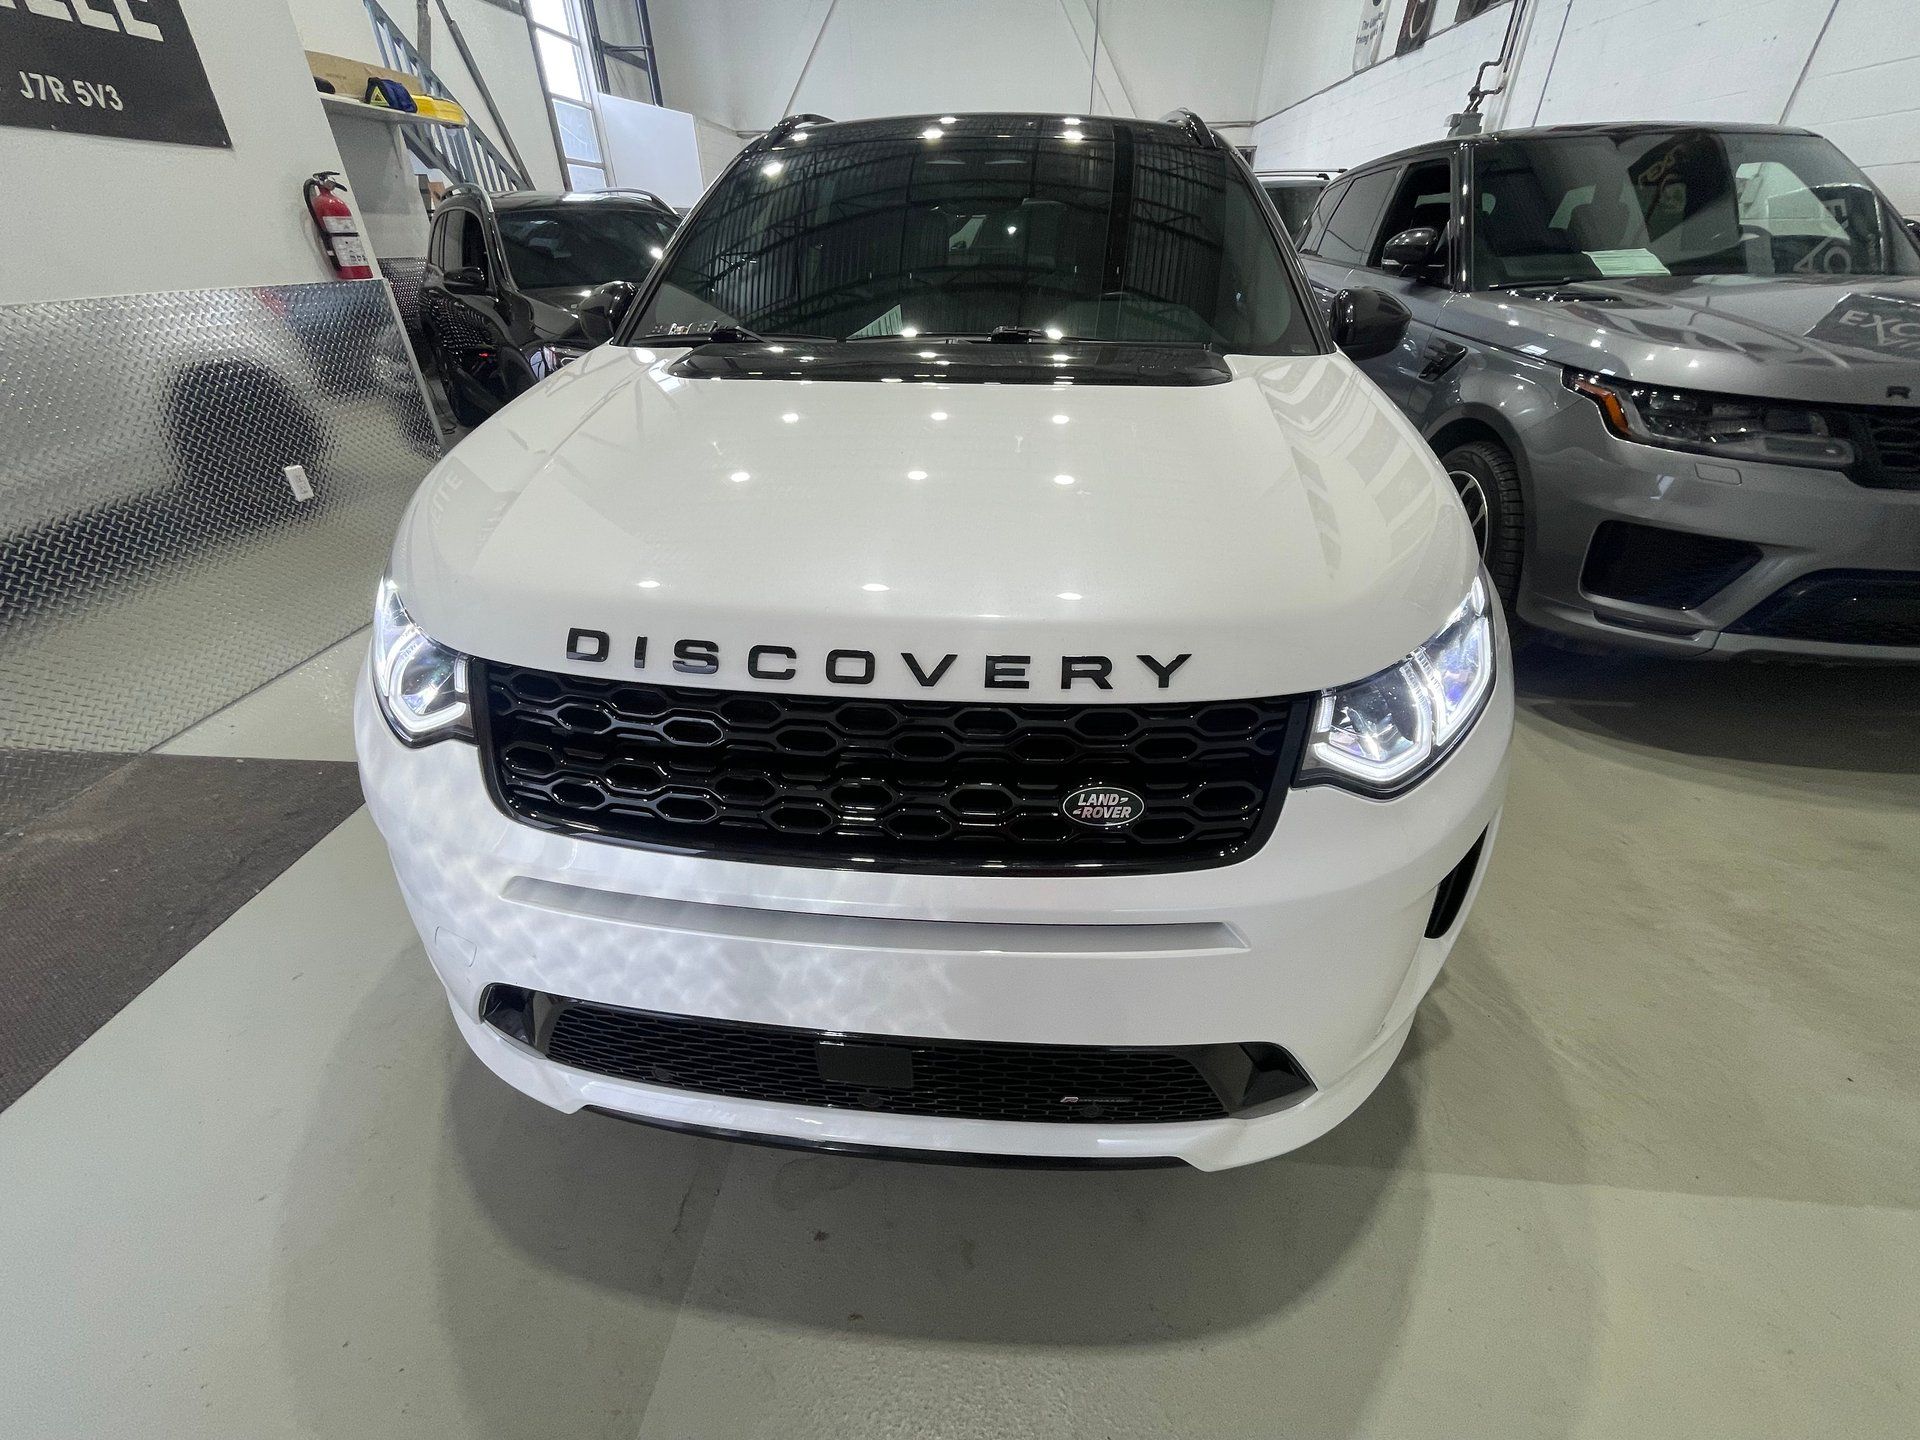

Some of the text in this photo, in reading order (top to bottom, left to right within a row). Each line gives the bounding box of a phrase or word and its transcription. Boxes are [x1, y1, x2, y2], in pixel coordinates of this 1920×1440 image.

[18, 70, 124, 112] J7R 5V3
[565, 627, 1193, 690] DISCOVERY
